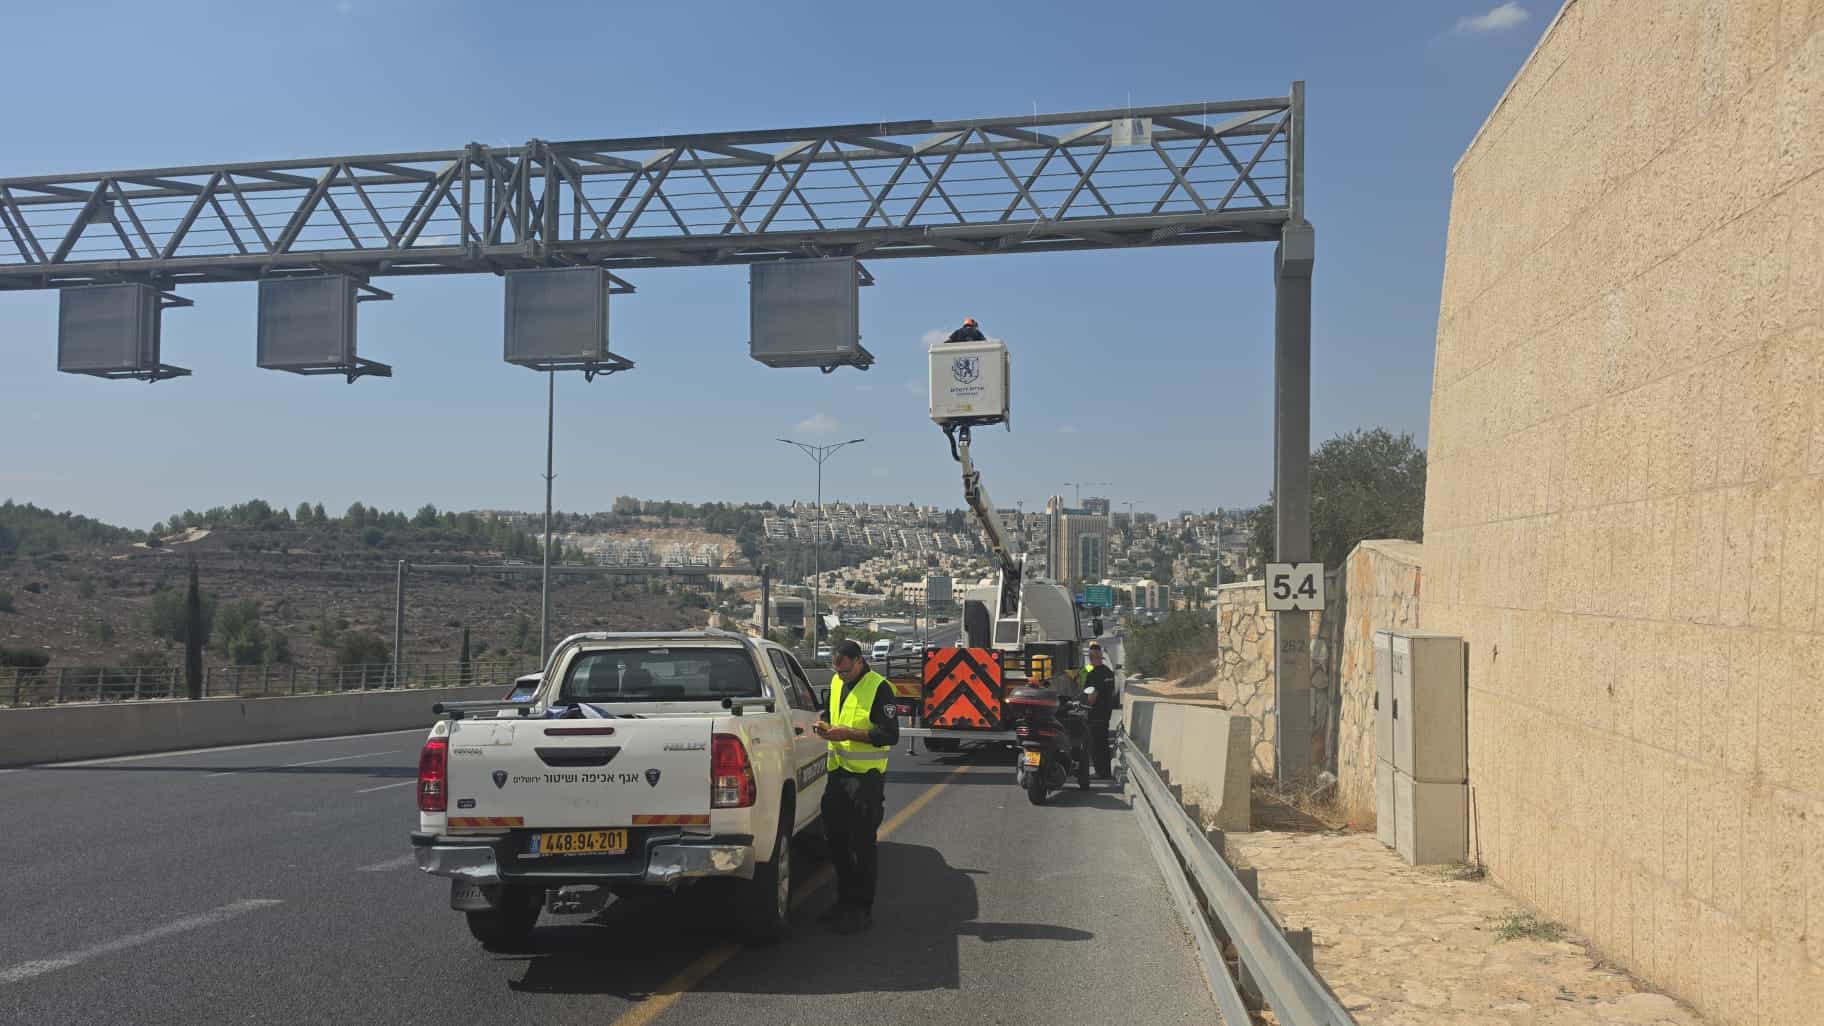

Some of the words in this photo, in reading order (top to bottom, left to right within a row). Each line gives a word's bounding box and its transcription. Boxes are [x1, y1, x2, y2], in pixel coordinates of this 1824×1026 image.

[1273, 574, 1317, 600] 5.4
[544, 774, 577, 783] ושיטור
[582, 774, 615, 783] אכיפה
